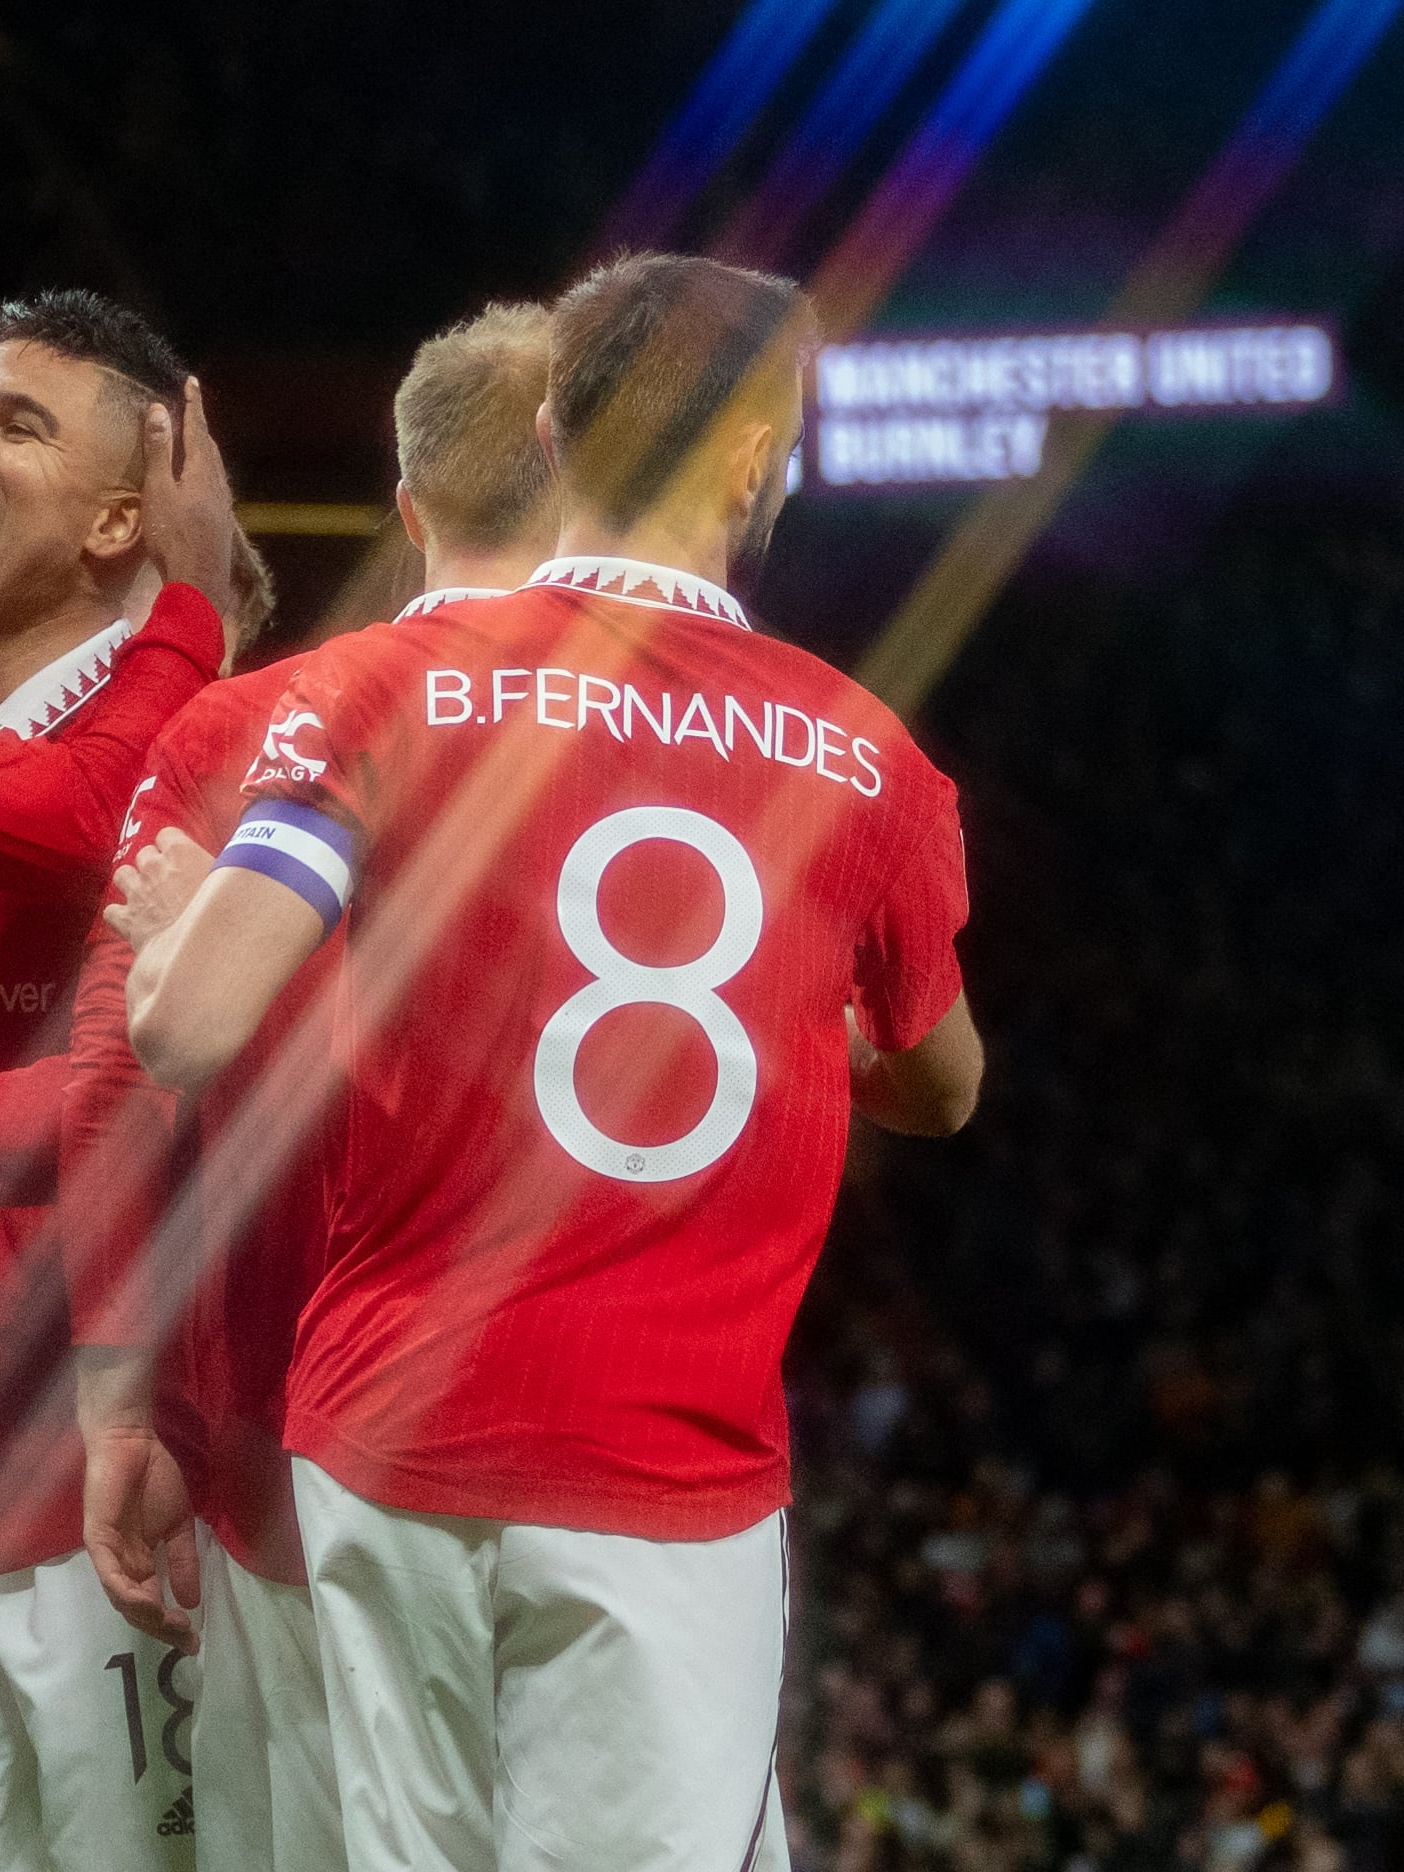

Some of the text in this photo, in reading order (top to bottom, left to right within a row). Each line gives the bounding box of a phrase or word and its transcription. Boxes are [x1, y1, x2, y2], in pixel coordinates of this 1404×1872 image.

[818, 325, 1333, 408] MANCHESTER UNITED
[818, 414, 1046, 484] BURNLEY
[425, 668, 882, 798] B.FERNANDES
[533, 806, 764, 1183] 8
